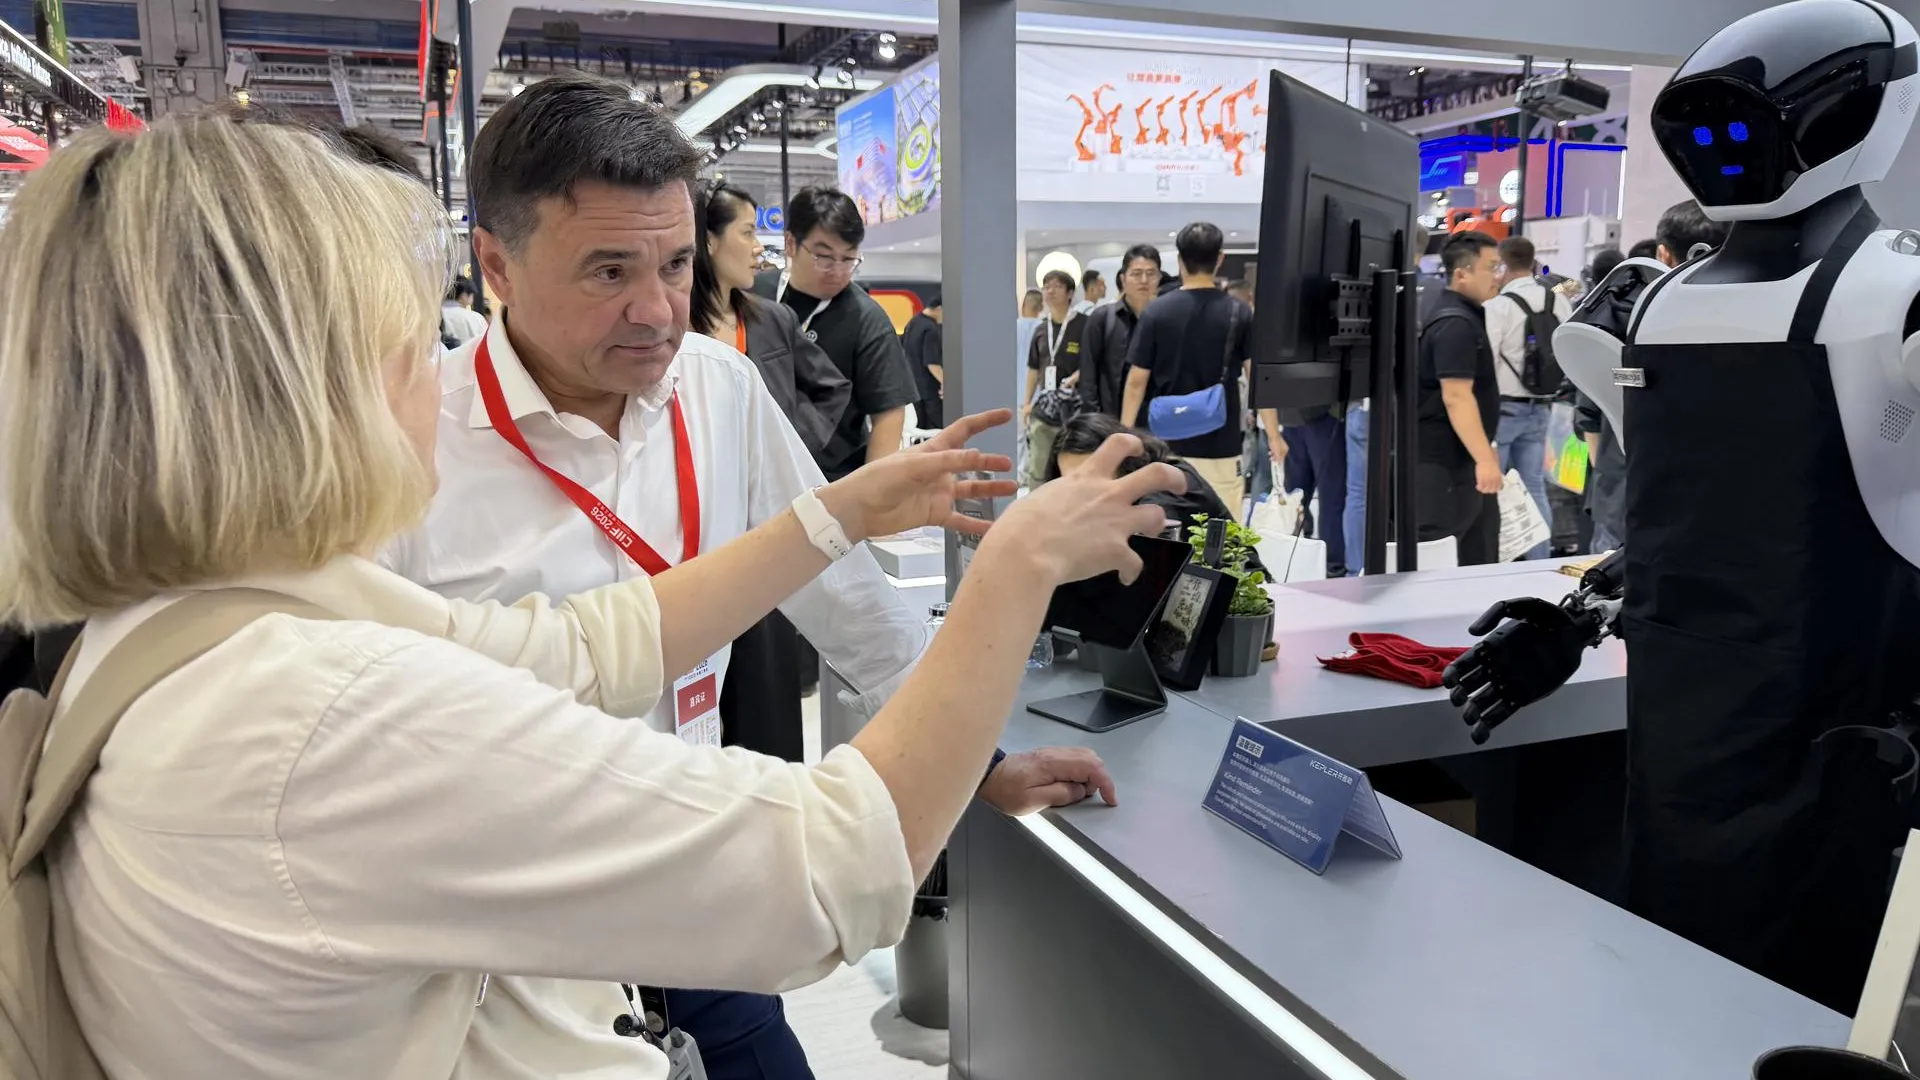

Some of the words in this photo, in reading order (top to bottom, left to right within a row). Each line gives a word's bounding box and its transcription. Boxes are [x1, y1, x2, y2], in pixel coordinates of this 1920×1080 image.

[590, 506, 613, 530] 2026
[609, 527, 633, 548] CIIF
[1238, 737, 1262, 757] 温馨提示
[1223, 771, 1236, 782] Kind
[1236, 777, 1263, 796] Reminder
